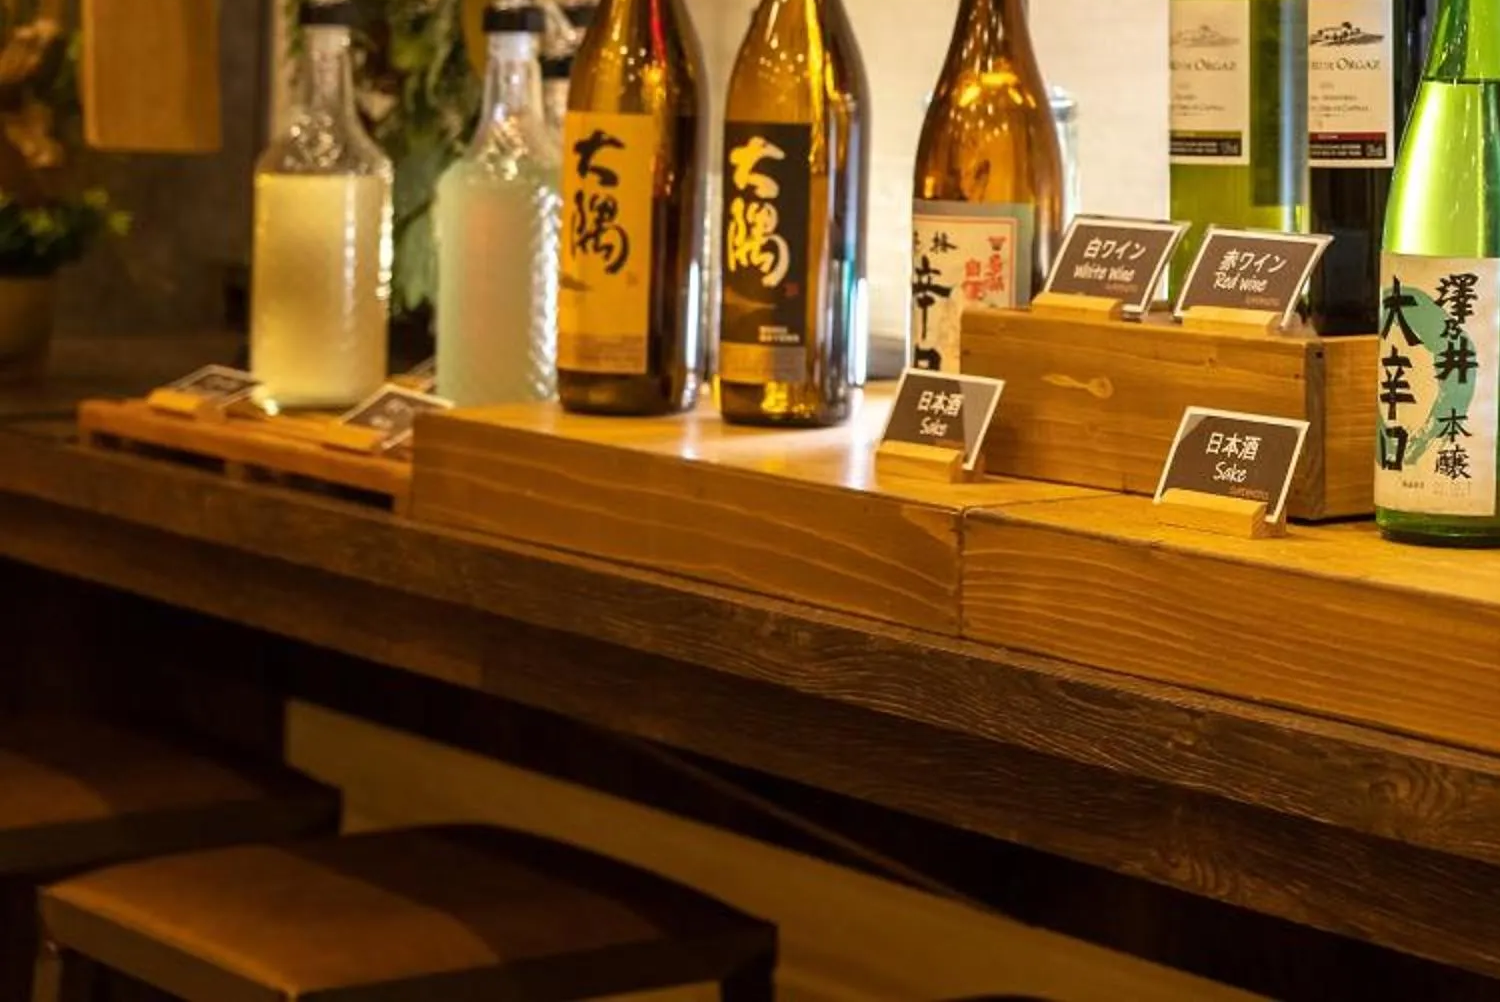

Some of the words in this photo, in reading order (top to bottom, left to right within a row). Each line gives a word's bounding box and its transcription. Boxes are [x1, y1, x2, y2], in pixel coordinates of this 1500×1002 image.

[1083, 236, 1147, 261] 白ワイン
[1218, 248, 1288, 275] 赤ワイン
[1379, 274, 1424, 472] 大辛口
[917, 390, 965, 417] 日本酒
[1205, 431, 1263, 462] 日本酒
[1212, 460, 1248, 484] Sake
